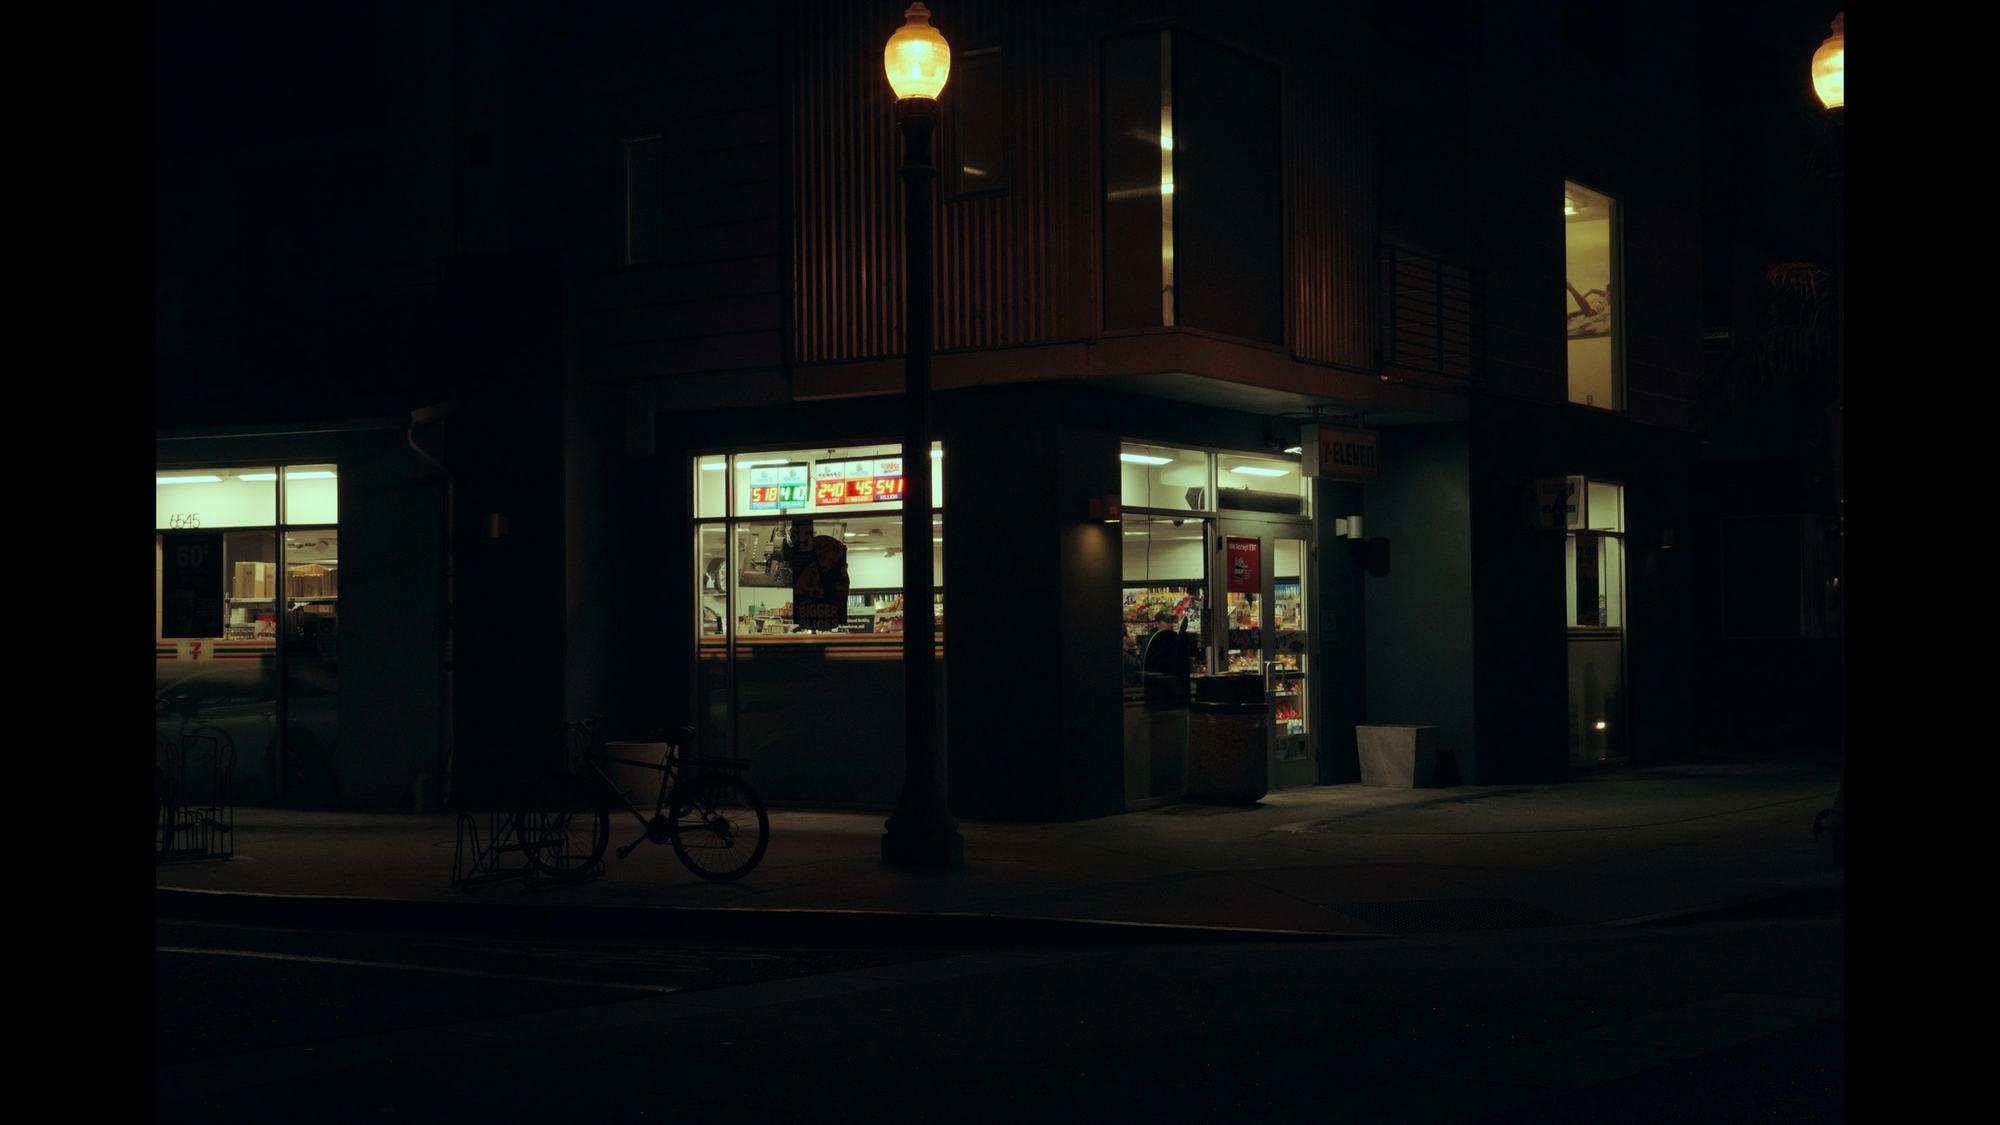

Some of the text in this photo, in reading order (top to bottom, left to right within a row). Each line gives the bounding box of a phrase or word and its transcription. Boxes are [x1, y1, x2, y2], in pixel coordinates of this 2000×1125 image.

[817, 483, 845, 499] 240
[169, 513, 201, 530] 6545
[799, 602, 839, 619] BIGGER
